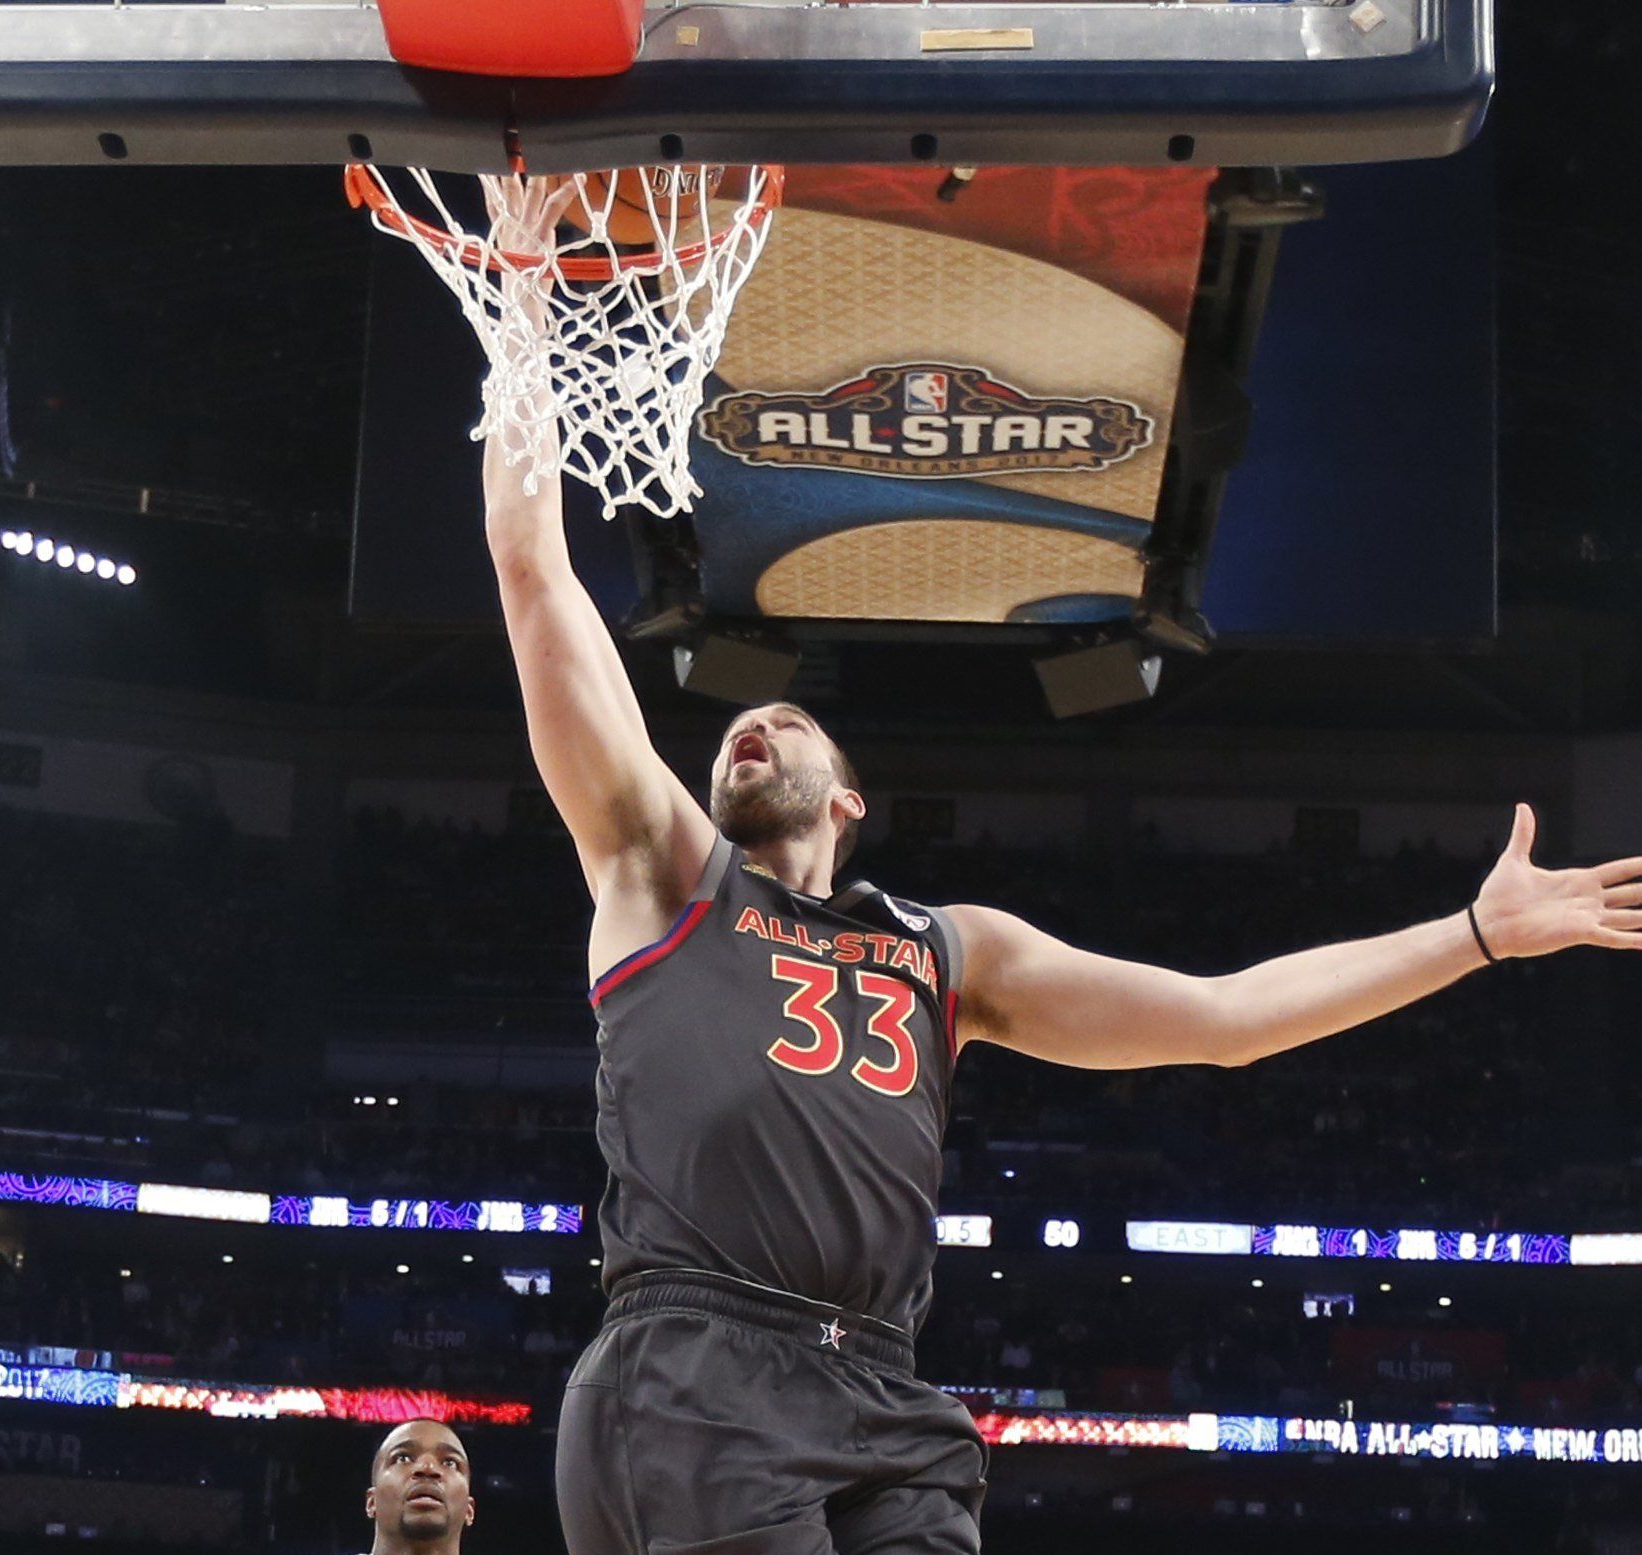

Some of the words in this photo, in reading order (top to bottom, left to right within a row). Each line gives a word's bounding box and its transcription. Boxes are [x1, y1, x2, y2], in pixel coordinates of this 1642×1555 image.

[767, 954, 919, 1097] 33
[1155, 1227, 1228, 1248] EAST
[1533, 1429, 1596, 1462] NEW
